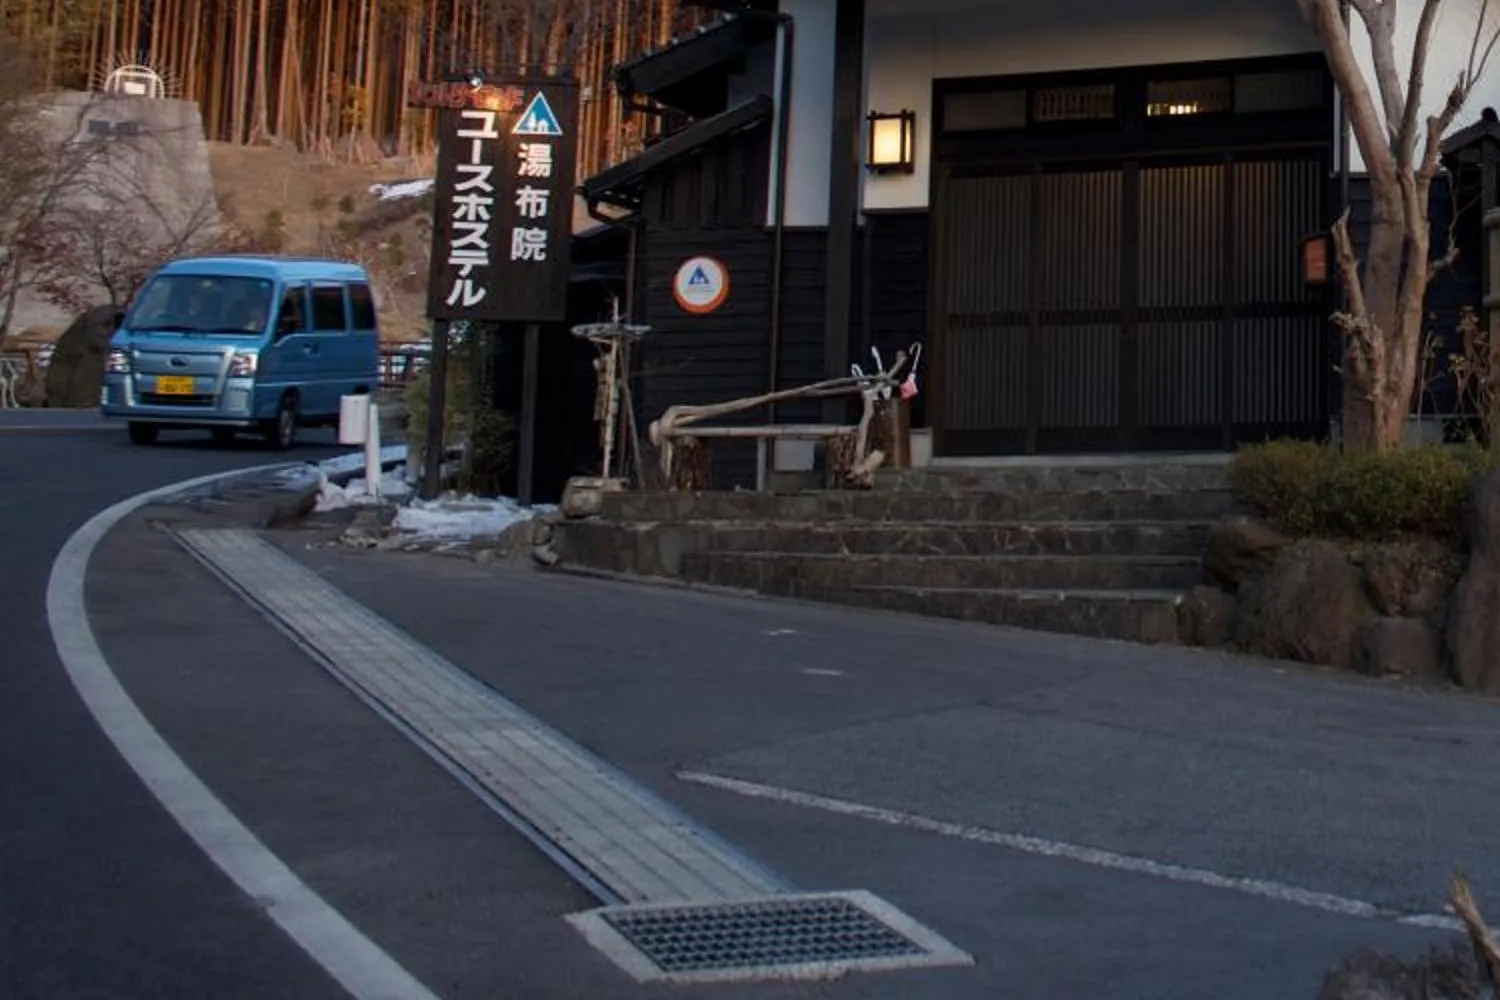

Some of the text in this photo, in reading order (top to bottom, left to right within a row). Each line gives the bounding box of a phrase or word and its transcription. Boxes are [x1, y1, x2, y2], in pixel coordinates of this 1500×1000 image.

[446, 110, 499, 307] ユースホステル
[511, 143, 553, 261] 湯布院
